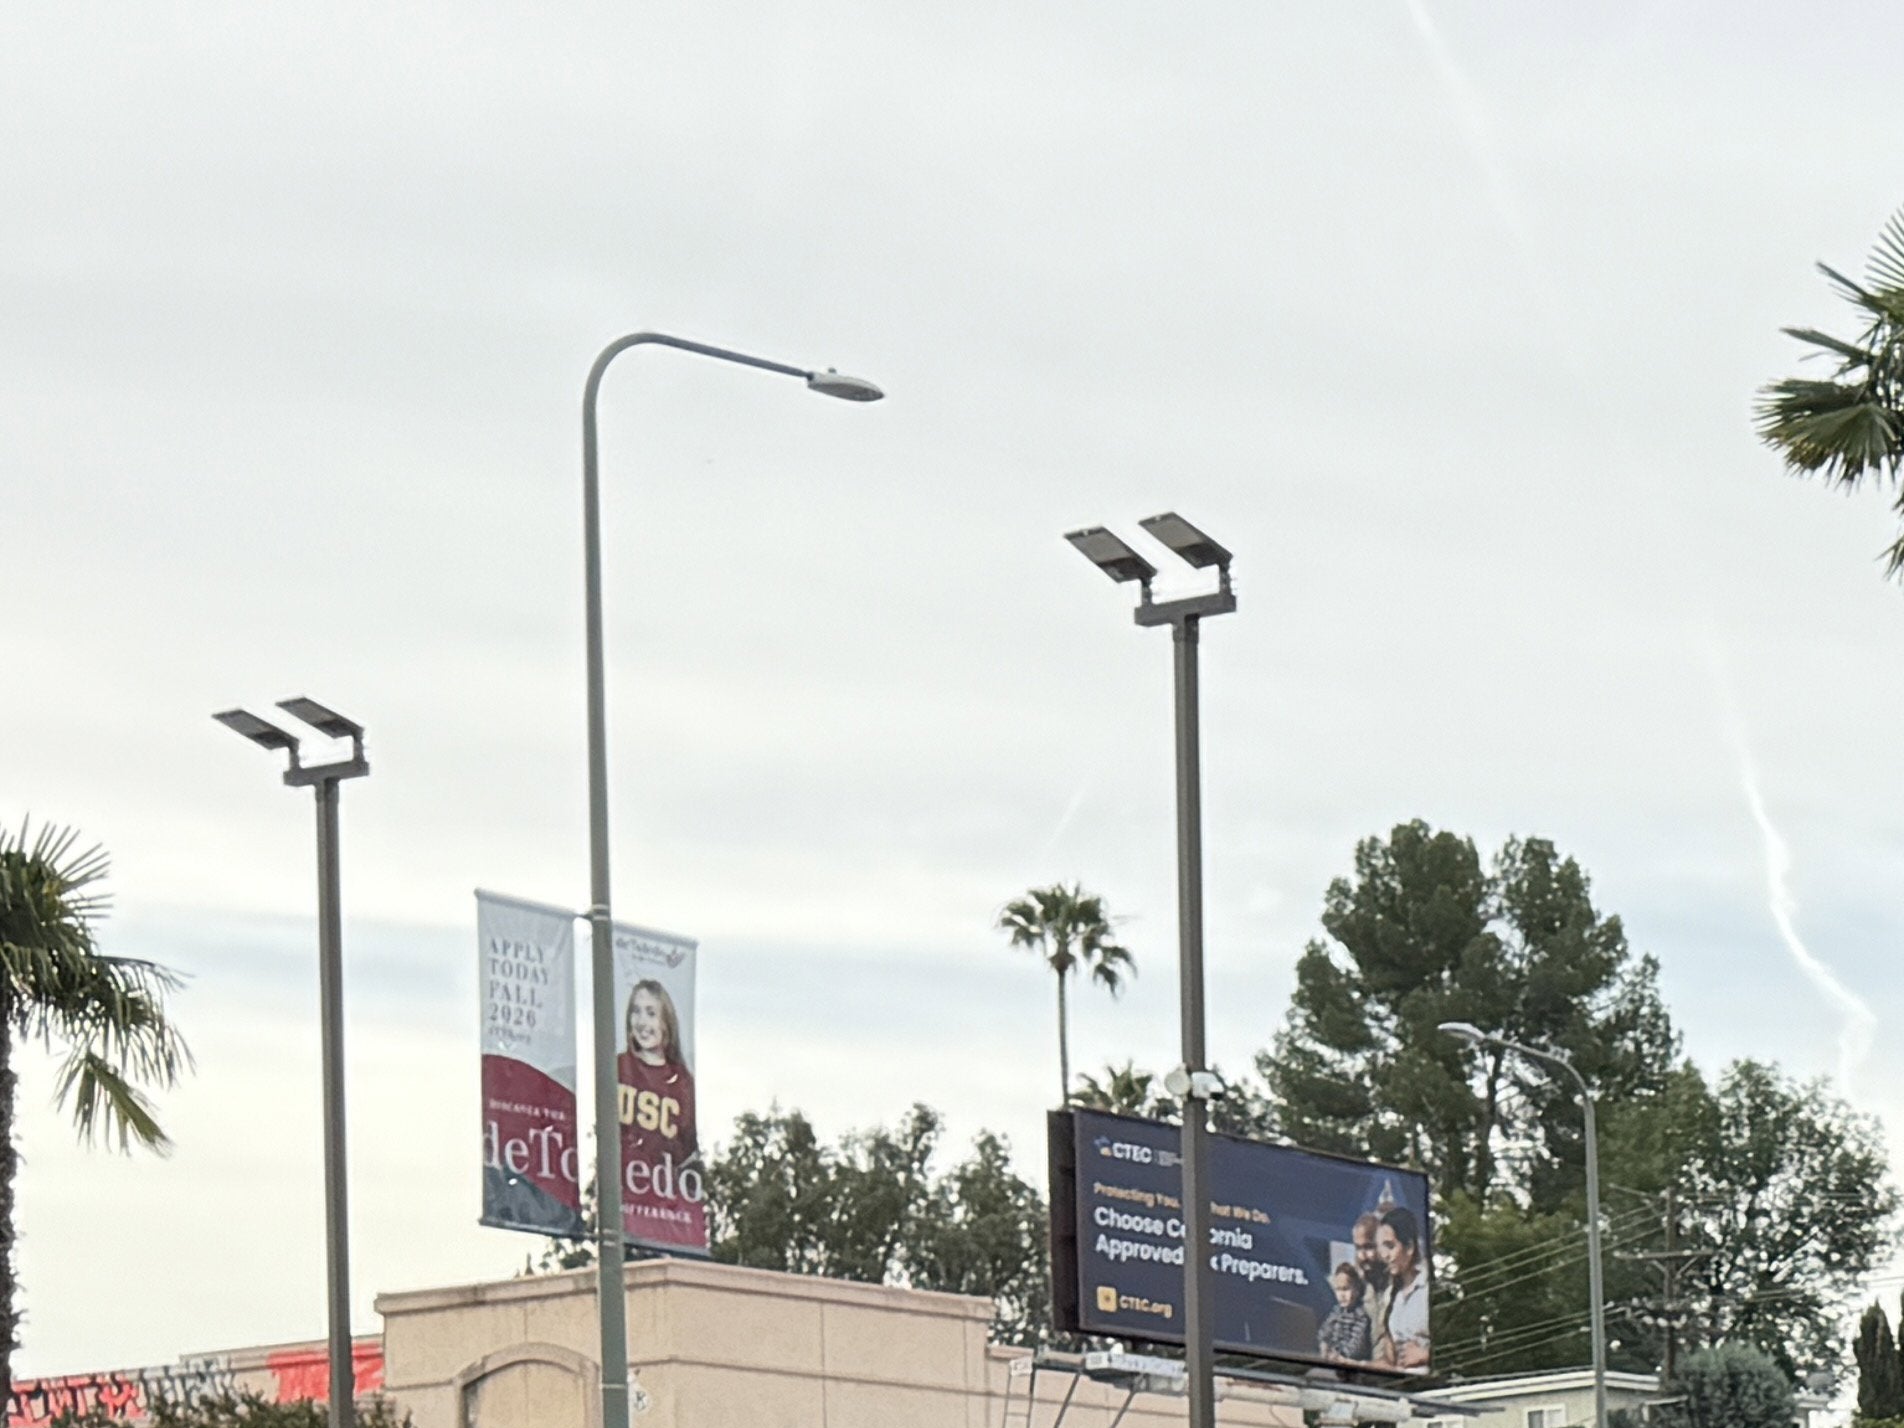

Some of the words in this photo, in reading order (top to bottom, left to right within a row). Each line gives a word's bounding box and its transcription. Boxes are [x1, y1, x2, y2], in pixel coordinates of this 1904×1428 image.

[489, 938, 544, 964] APPLY
[488, 957, 549, 985] TODAY
[489, 980, 543, 1008] FALL
[619, 1083, 680, 1138] USC
[1113, 1142, 1152, 1164] CTEC
[1094, 1206, 1164, 1236] Choose
[1095, 1233, 1185, 1266] Approved
[1221, 1252, 1309, 1285] Preparers.
